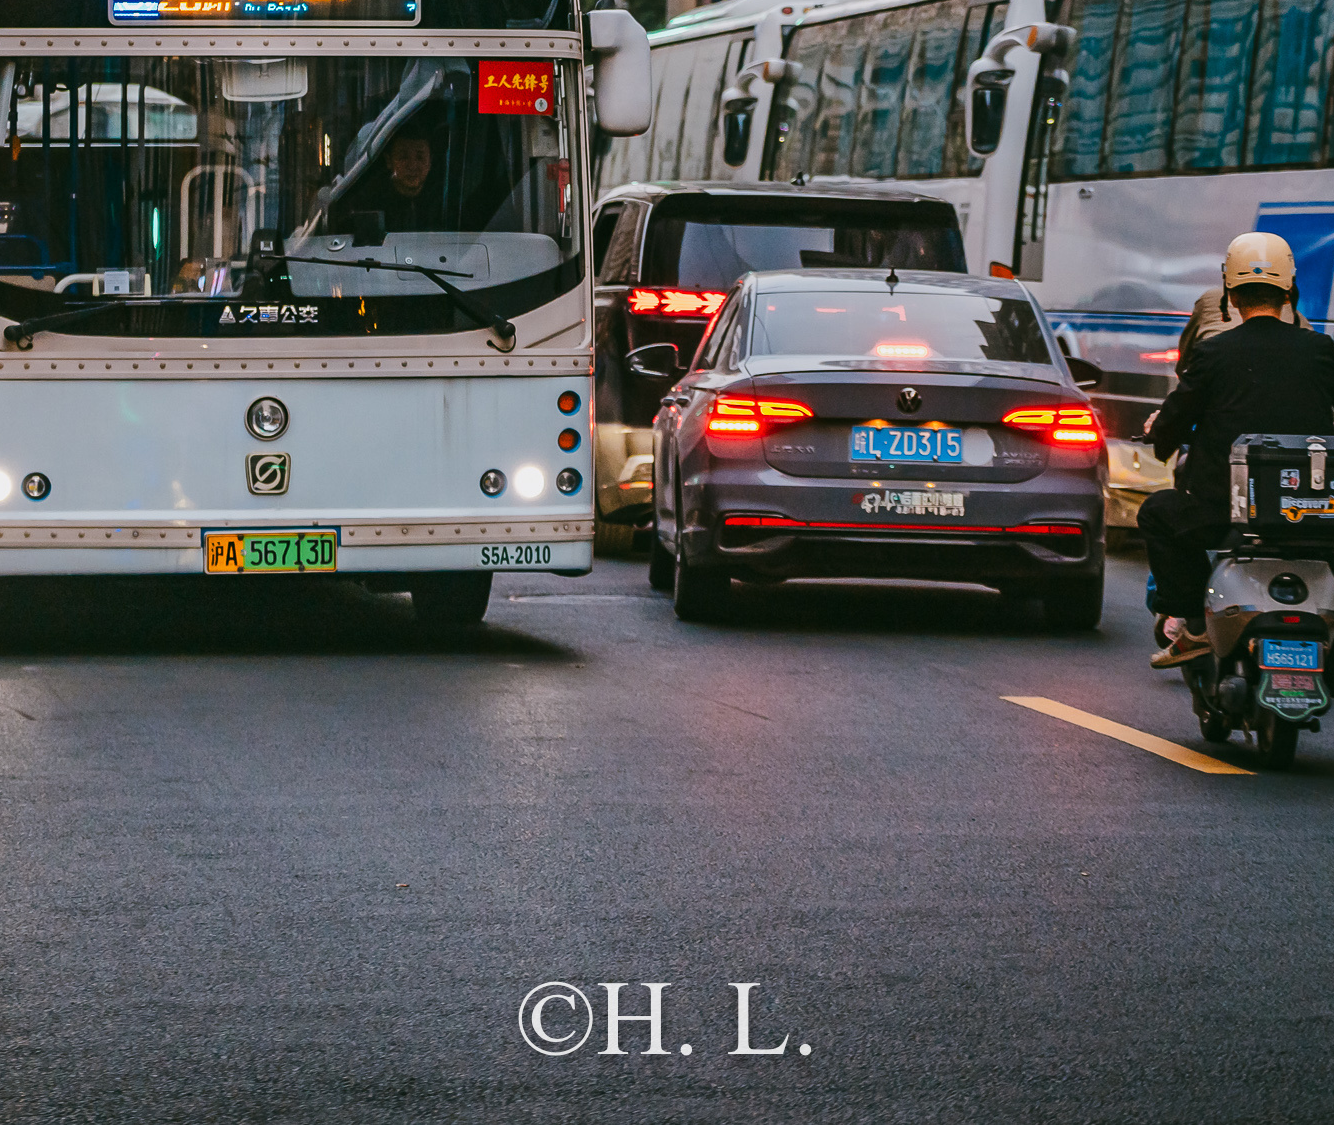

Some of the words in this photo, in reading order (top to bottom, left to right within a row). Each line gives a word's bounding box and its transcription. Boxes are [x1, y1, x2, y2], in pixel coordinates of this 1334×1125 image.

[483, 73, 549, 93] 工人先锋号
[480, 544, 551, 566] S5A-2010
